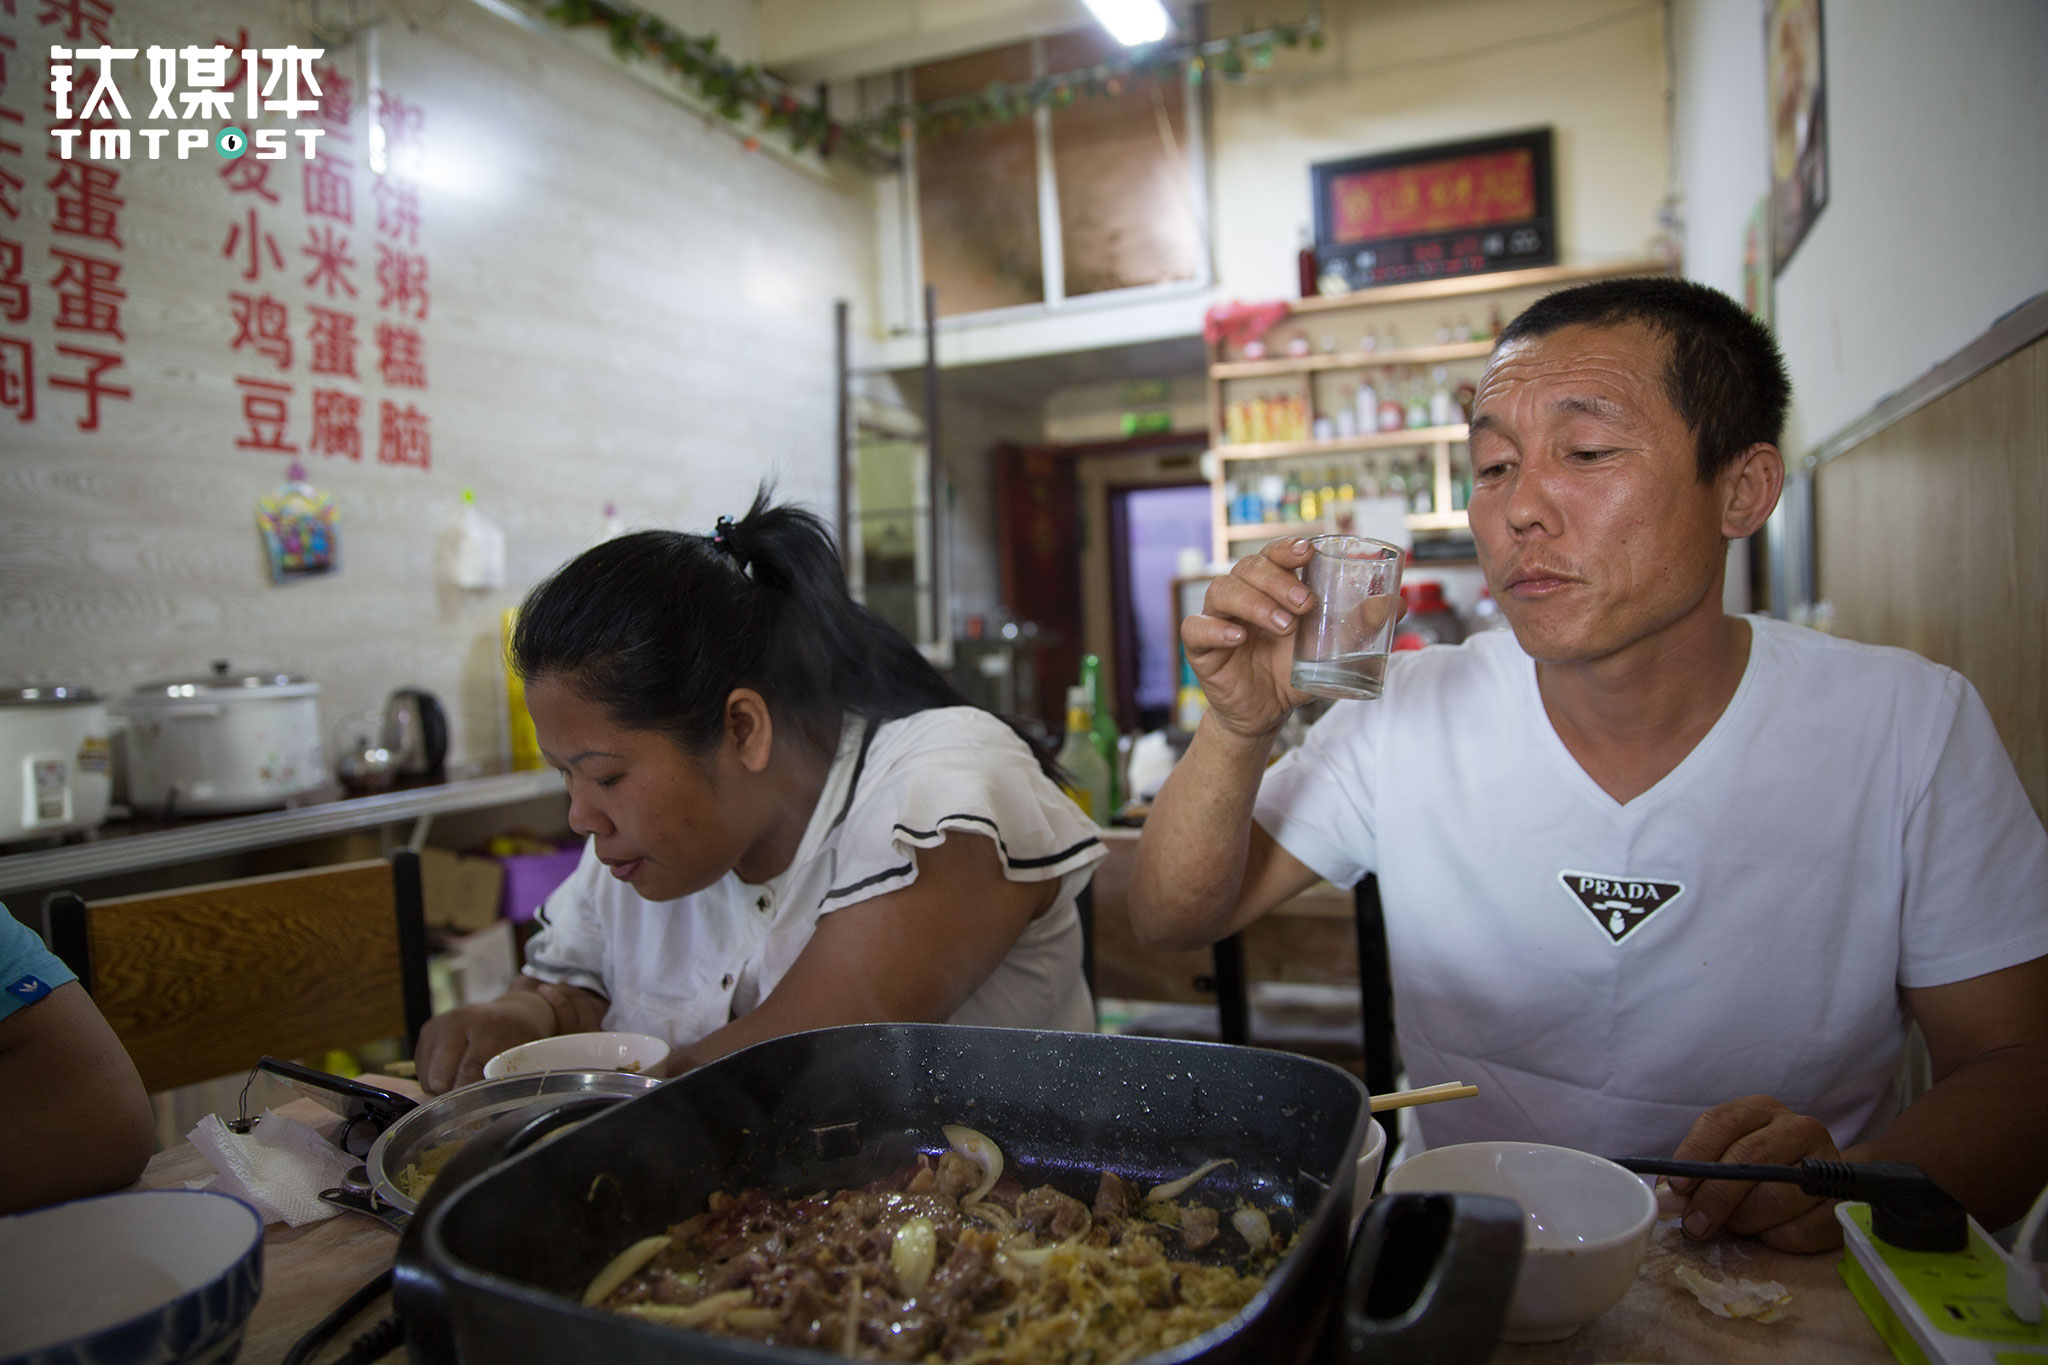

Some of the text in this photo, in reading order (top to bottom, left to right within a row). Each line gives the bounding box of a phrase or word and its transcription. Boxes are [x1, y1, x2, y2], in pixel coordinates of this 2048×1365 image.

[221, 206, 430, 321] 小米粥
[228, 291, 430, 391] 鸡蛋糕
[234, 373, 433, 471] 豆腐脑
[1579, 877, 1661, 901] PRADA
